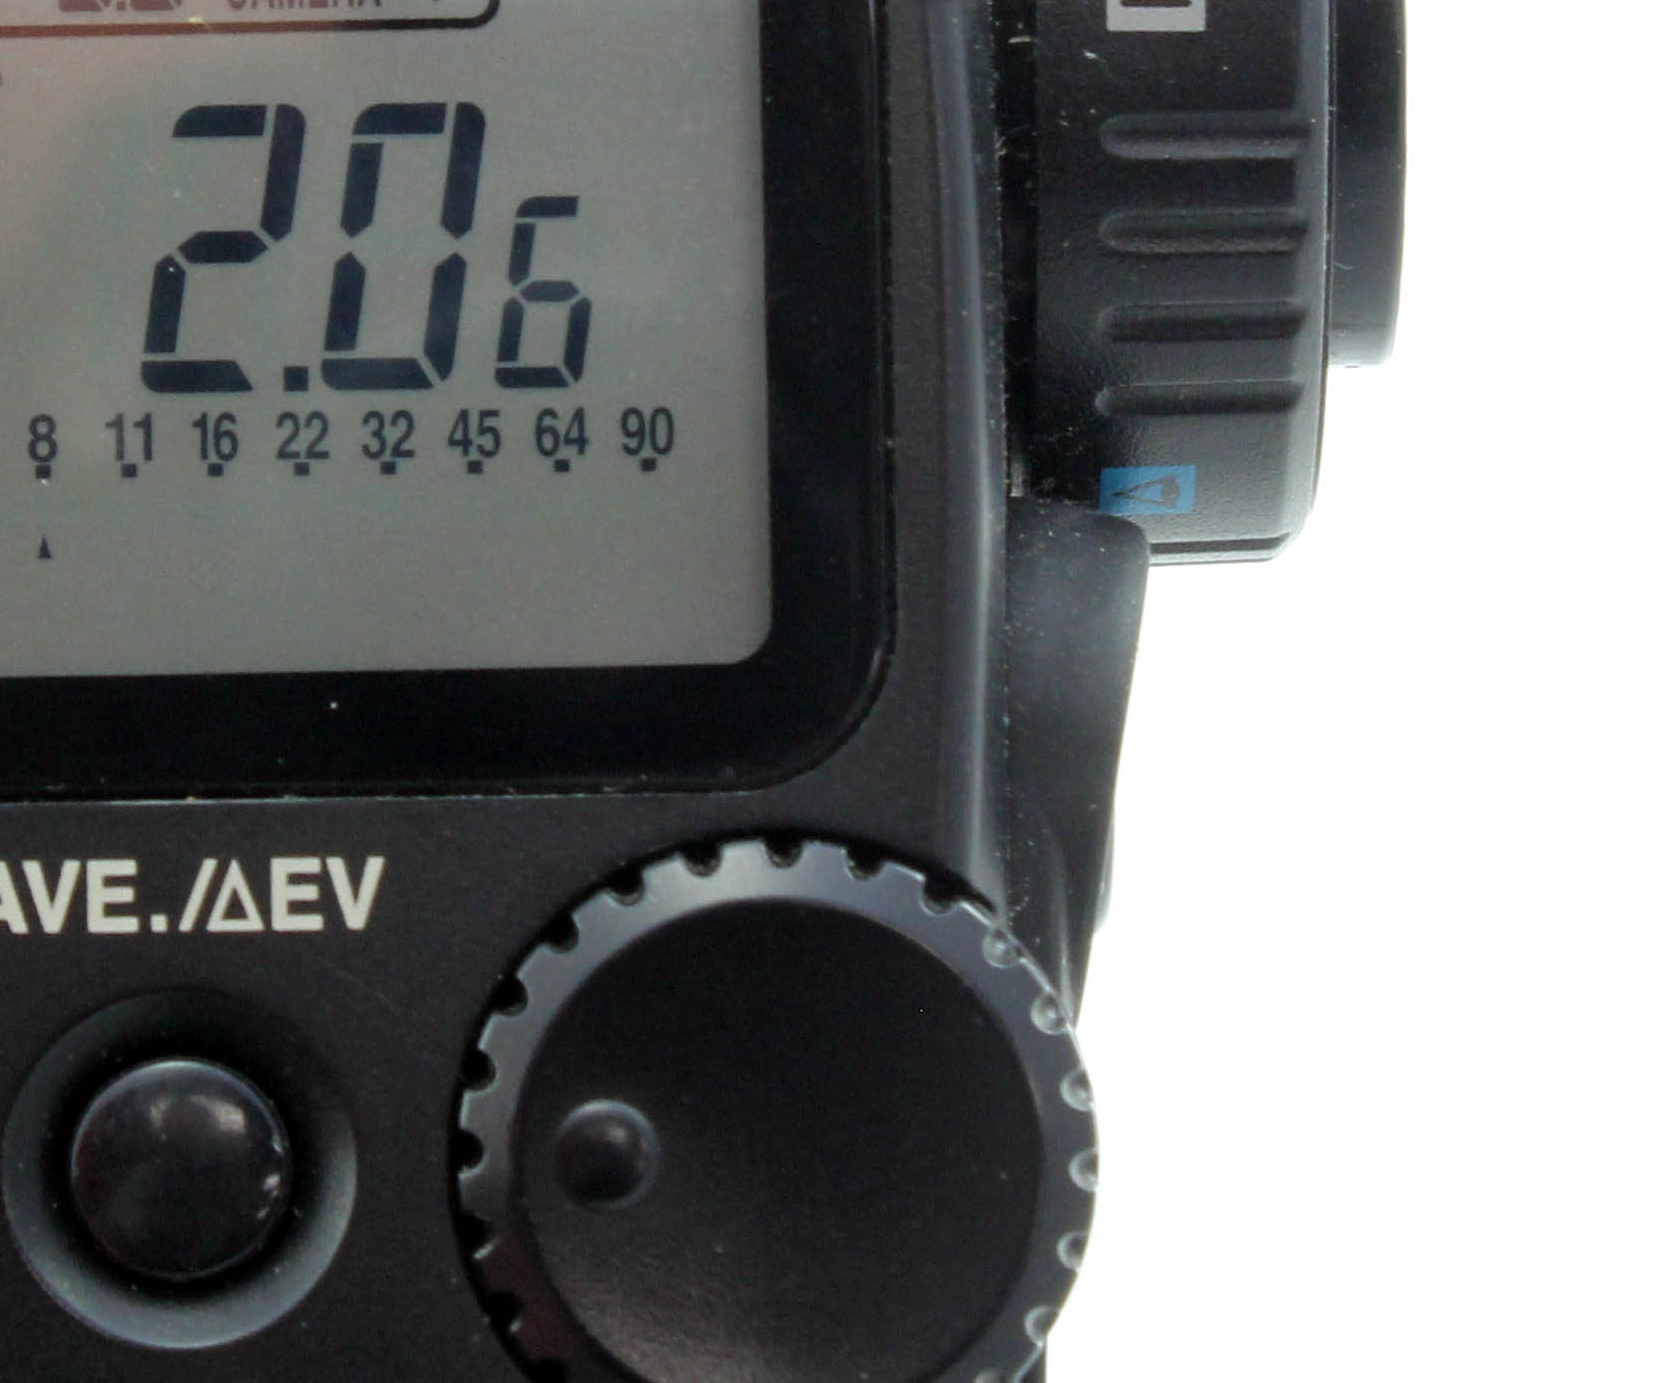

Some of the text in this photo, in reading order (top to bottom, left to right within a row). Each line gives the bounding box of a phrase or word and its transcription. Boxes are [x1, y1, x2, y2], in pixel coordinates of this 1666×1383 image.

[27, 413, 58, 464] 8
[105, 412, 155, 463] 11
[192, 411, 239, 462] 16
[275, 410, 330, 461] 22
[361, 409, 416, 460] 32
[447, 408, 502, 458] 45
[534, 407, 590, 457] 64
[620, 407, 675, 457] 90
